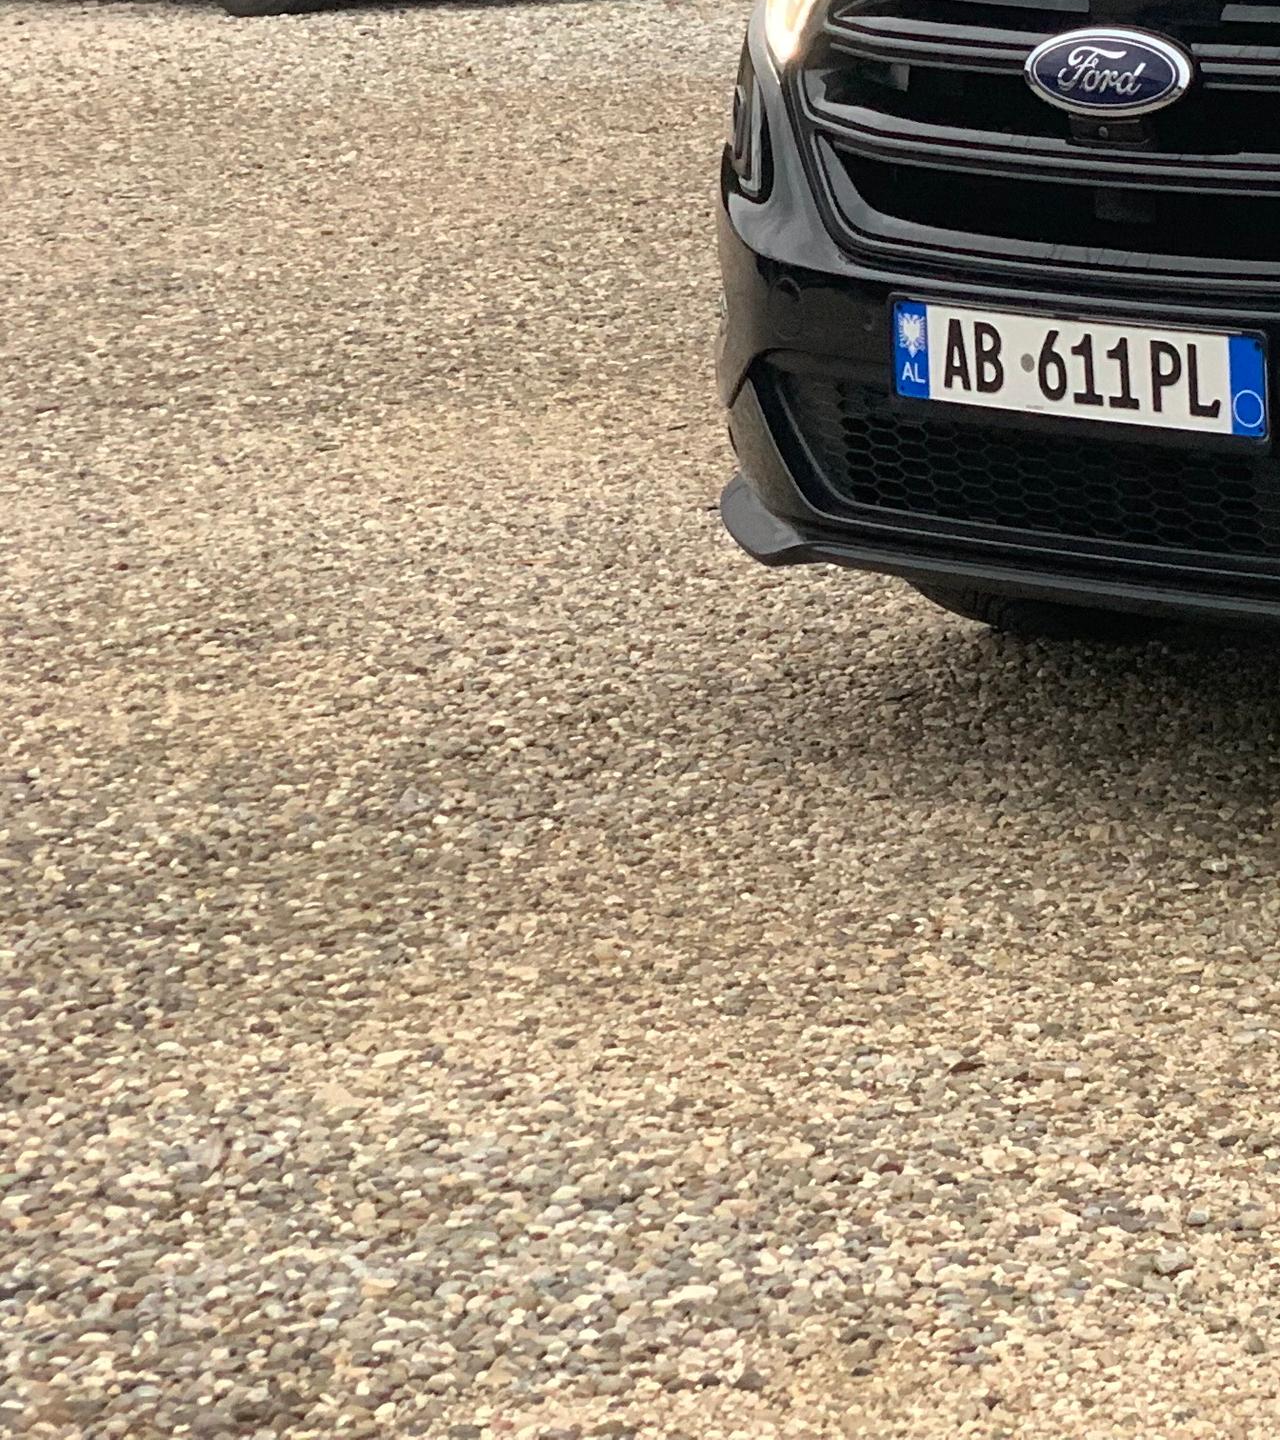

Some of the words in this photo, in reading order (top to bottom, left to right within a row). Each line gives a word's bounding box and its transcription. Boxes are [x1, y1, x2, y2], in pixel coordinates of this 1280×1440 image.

[1057, 45, 1147, 96] Ford
[901, 361, 927, 384] AL
[943, 317, 1005, 394] AB
